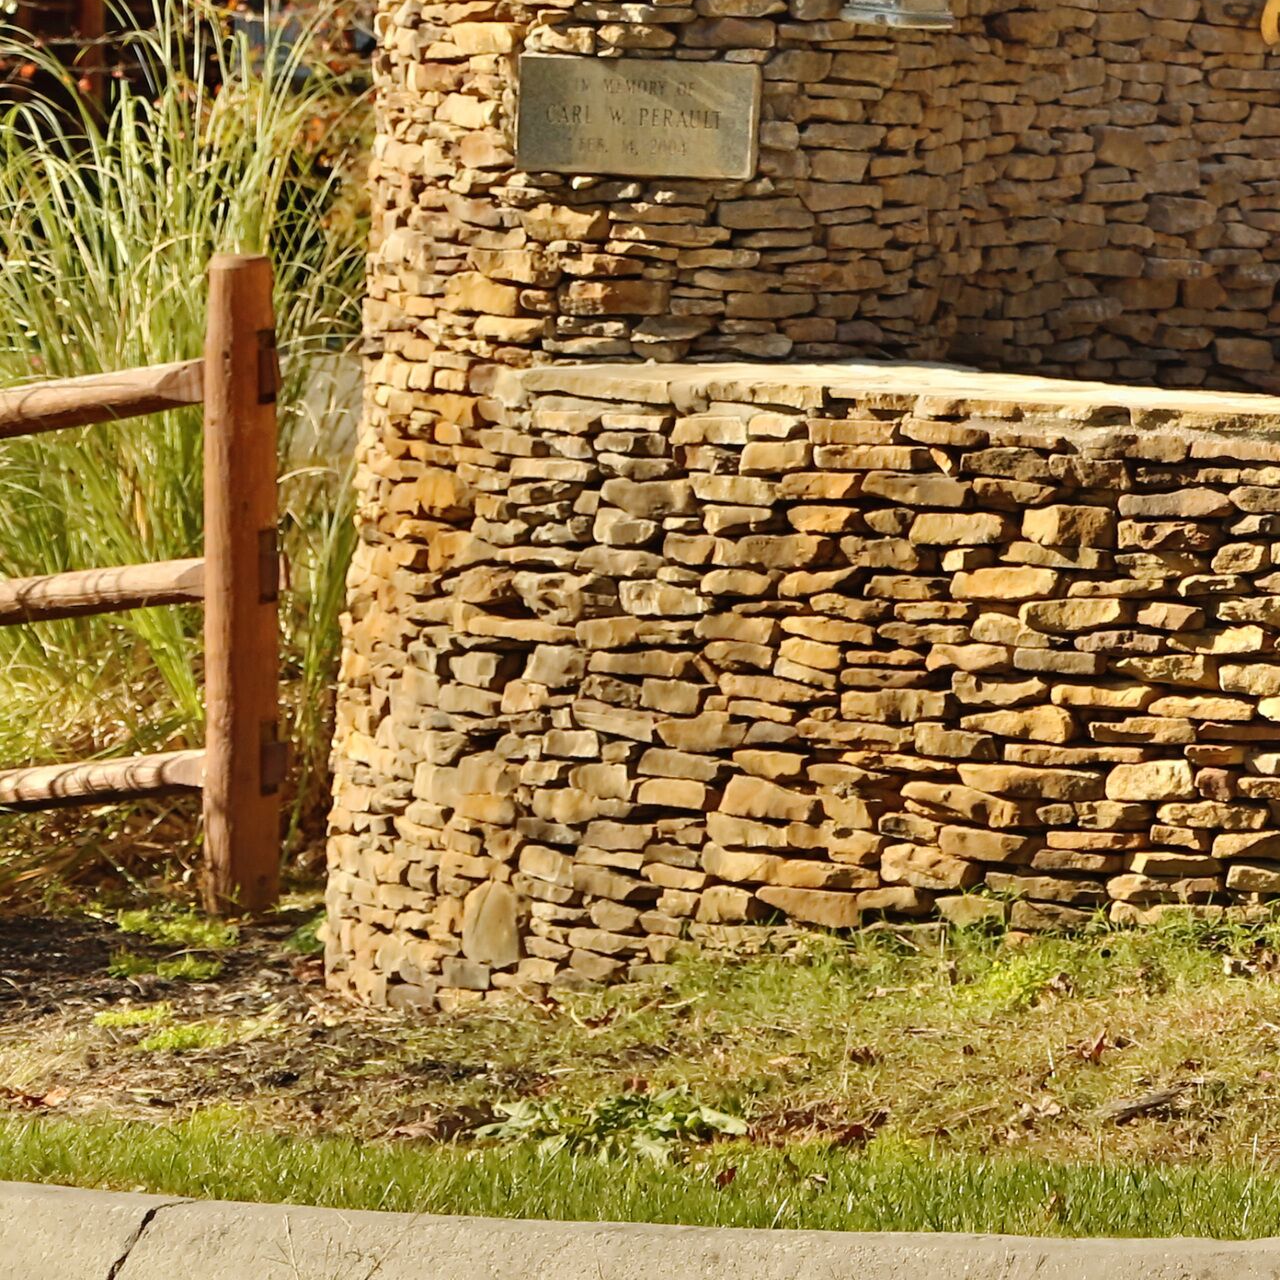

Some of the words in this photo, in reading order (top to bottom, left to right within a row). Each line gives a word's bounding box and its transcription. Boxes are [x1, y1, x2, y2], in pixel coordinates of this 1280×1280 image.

[603, 78, 667, 96] MEMORY
[676, 81, 696, 97] OF
[545, 103, 592, 125] CARL
[609, 105, 627, 127] W.
[639, 107, 723, 130] PERAULT
